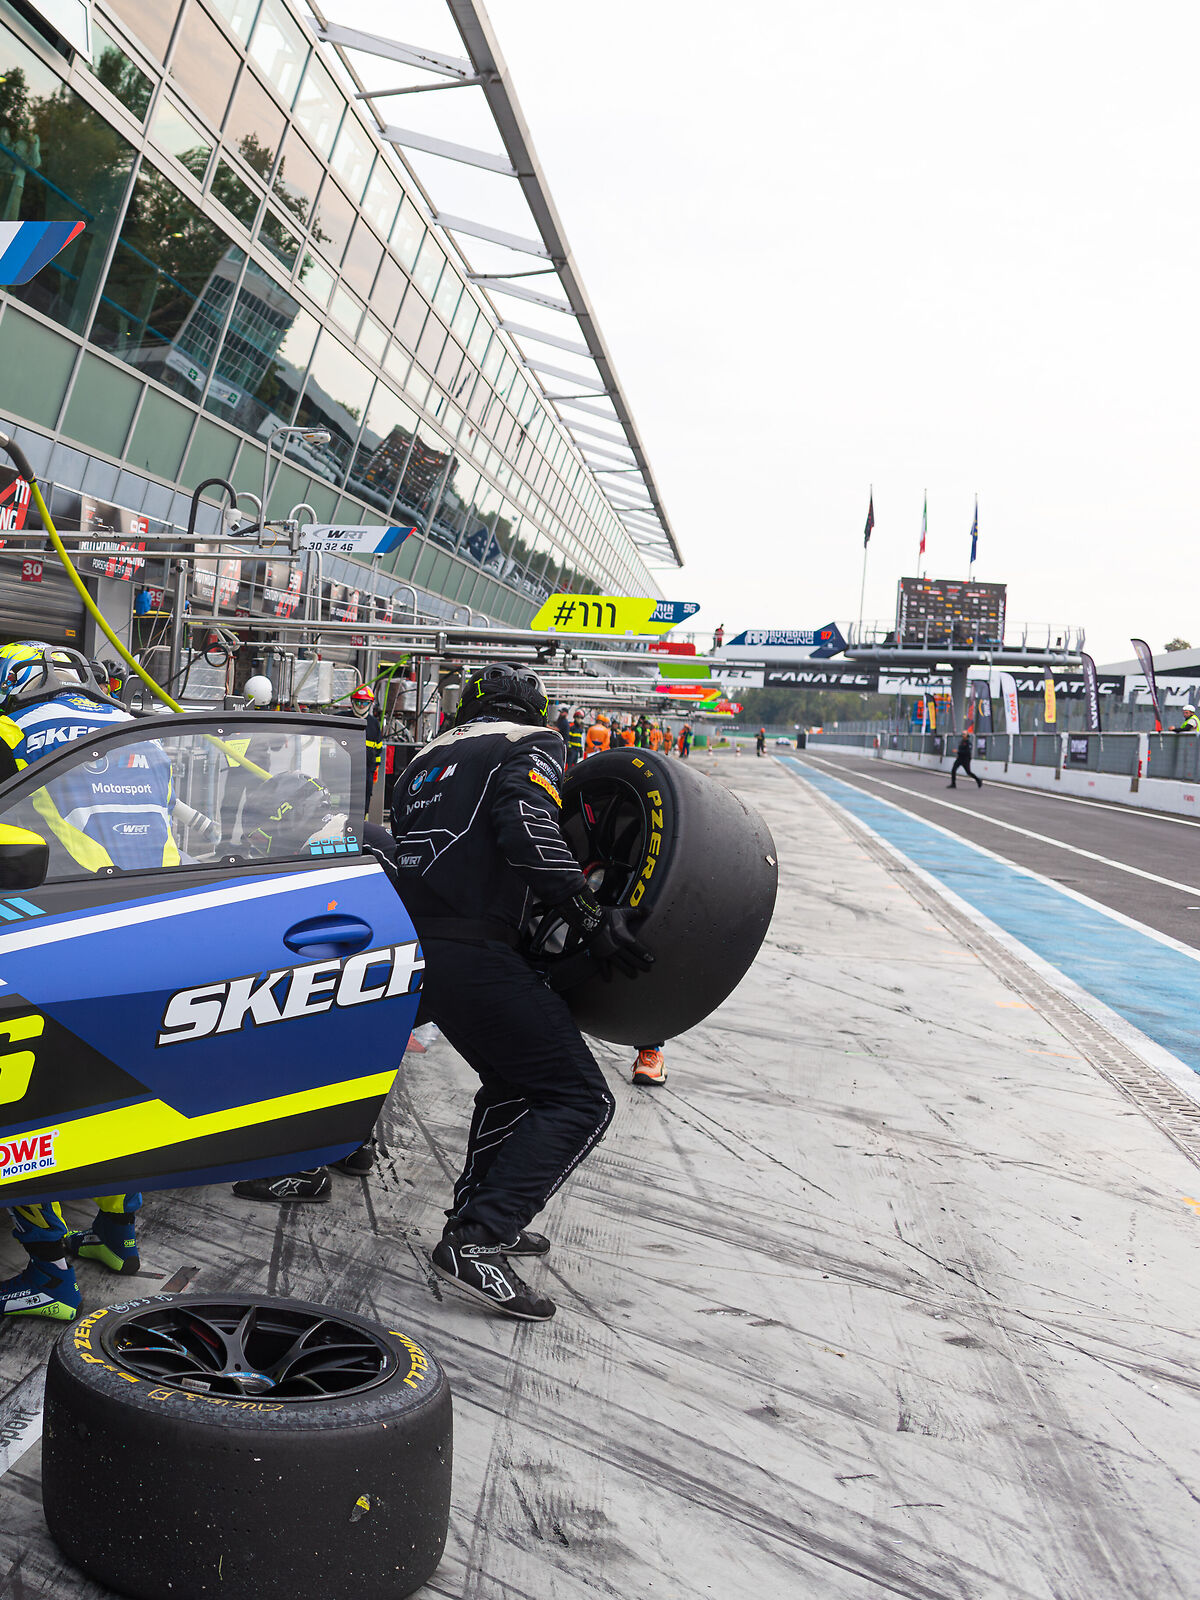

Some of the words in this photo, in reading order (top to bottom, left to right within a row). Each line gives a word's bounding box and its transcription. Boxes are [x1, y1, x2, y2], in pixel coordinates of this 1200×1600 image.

[326, 529, 368, 539] WRT
[308, 541, 322, 551] 30
[324, 542, 338, 551] 32
[340, 543, 353, 551] 46
[23, 563, 42, 576] 30
[553, 600, 617, 628] #111
[683, 603, 697, 613] 96
[768, 637, 814, 645] RACING
[768, 671, 871, 685] FANATEC
[1015, 677, 1113, 695] FANATC
[91, 782, 153, 796] Motorsport
[123, 824, 151, 833] WRT
[308, 835, 358, 847] GoPro
[2, 1161, 37, 1178] MOTOR
[38, 1157, 55, 1171] OIL
